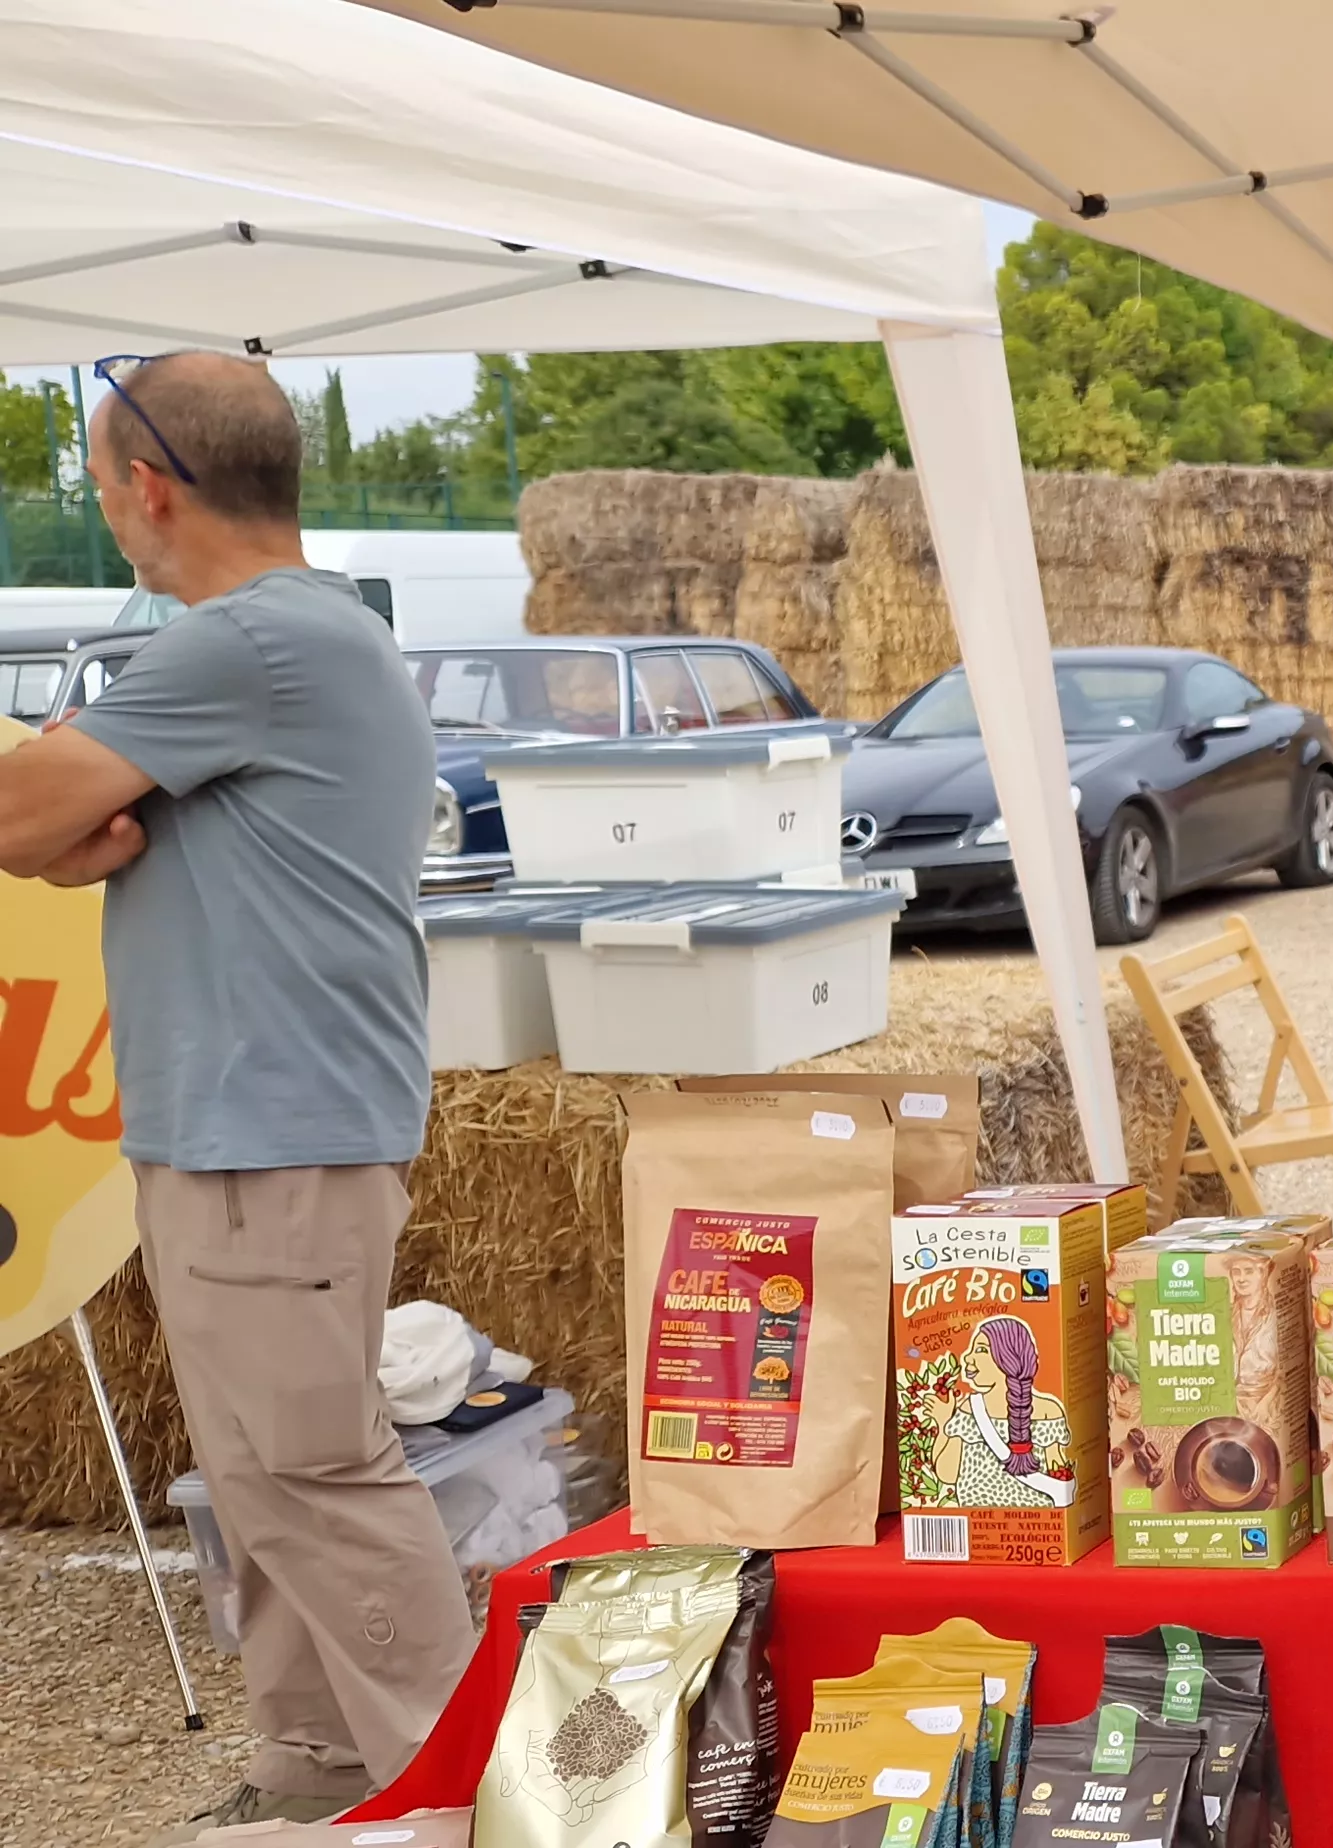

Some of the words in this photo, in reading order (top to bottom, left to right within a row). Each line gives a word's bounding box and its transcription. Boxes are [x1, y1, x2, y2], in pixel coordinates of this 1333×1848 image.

[778, 812, 796, 832] 07
[612, 822, 637, 843] 07
[812, 981, 829, 1005] 08
[696, 1217, 752, 1226] COMERCIO
[916, 1229, 938, 1245] La
[947, 1227, 1007, 1242] Cesta
[668, 1269, 729, 1295] CAFE
[1168, 1280, 1193, 1288] OXFAM
[902, 1270, 960, 1319] Café
[1164, 1289, 1199, 1298] Intermón
[664, 1295, 751, 1312] NICARAGUA
[907, 1308, 958, 1331] Agricultura
[963, 1304, 1008, 1317] ecológica
[1150, 1309, 1215, 1336] Tierra
[661, 1320, 708, 1333] NATURAL
[912, 1322, 971, 1347] Comercio
[923, 1338, 953, 1353] Justo
[1149, 1340, 1220, 1366] Madre
[1158, 1376, 1178, 1386] CAFÉ
[1180, 1377, 1215, 1386] MOLIDO
[1174, 1387, 1201, 1400] BIO
[970, 1510, 994, 1519] CAFÉ
[1186, 1518, 1215, 1526] MUNDO
[1217, 1517, 1232, 1525] MÁS
[972, 1522, 1009, 1530] TUESTE
[1172, 1696, 1192, 1704] OXFAM
[734, 1740, 755, 1751] en
[1103, 1749, 1124, 1757] OXFAM
[834, 1766, 849, 1774] por
[789, 1772, 867, 1792] mujeres
[1082, 1782, 1127, 1802] Tierra
[1072, 1802, 1121, 1823] Madre
[1052, 1828, 1100, 1839] COMERCIO
[1101, 1831, 1130, 1841] JUSTO
